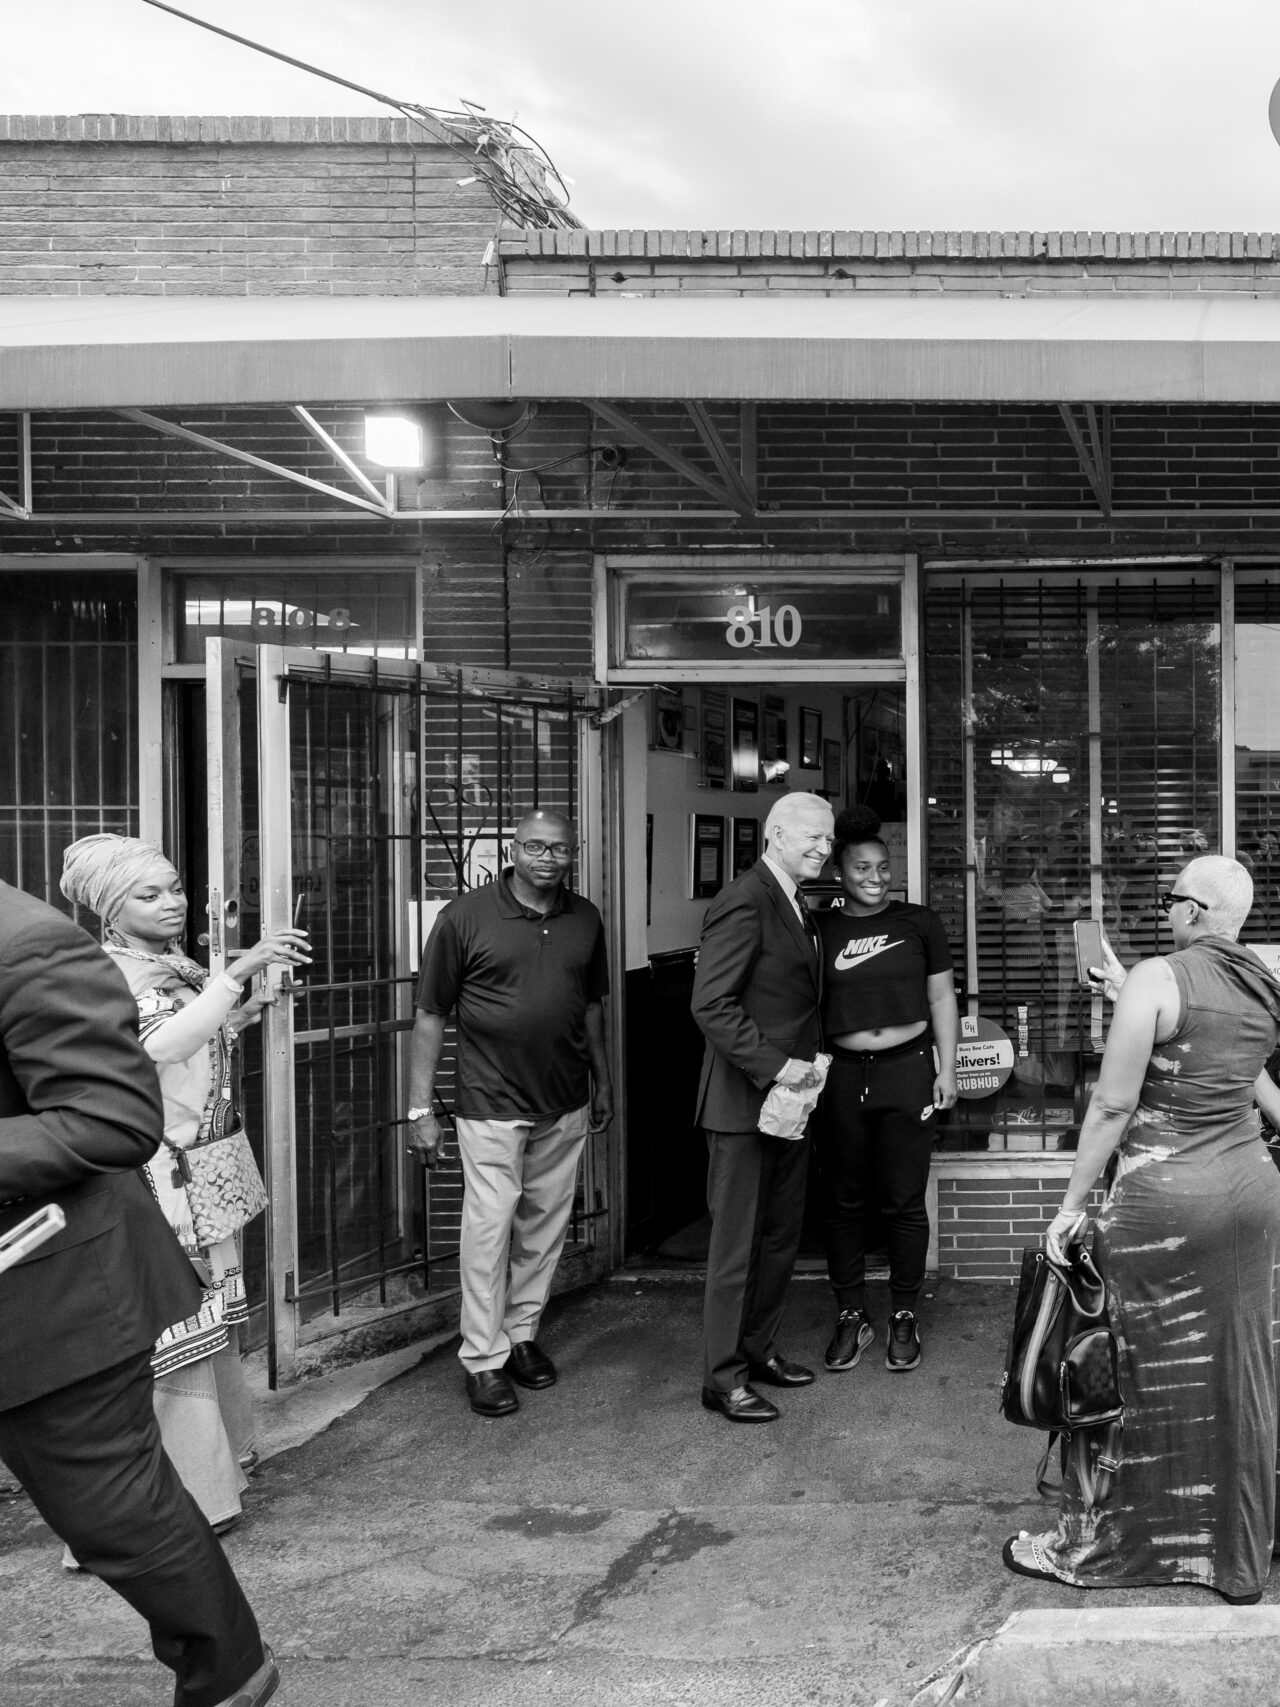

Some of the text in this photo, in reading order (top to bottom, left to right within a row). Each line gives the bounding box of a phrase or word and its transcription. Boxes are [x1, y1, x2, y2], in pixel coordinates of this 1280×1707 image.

[250, 606, 350, 631] 808
[725, 604, 802, 648] 810
[844, 934, 888, 956] NIKE
[956, 1053, 1000, 1068] elivers!
[957, 1076, 1000, 1091] RUBHUB
